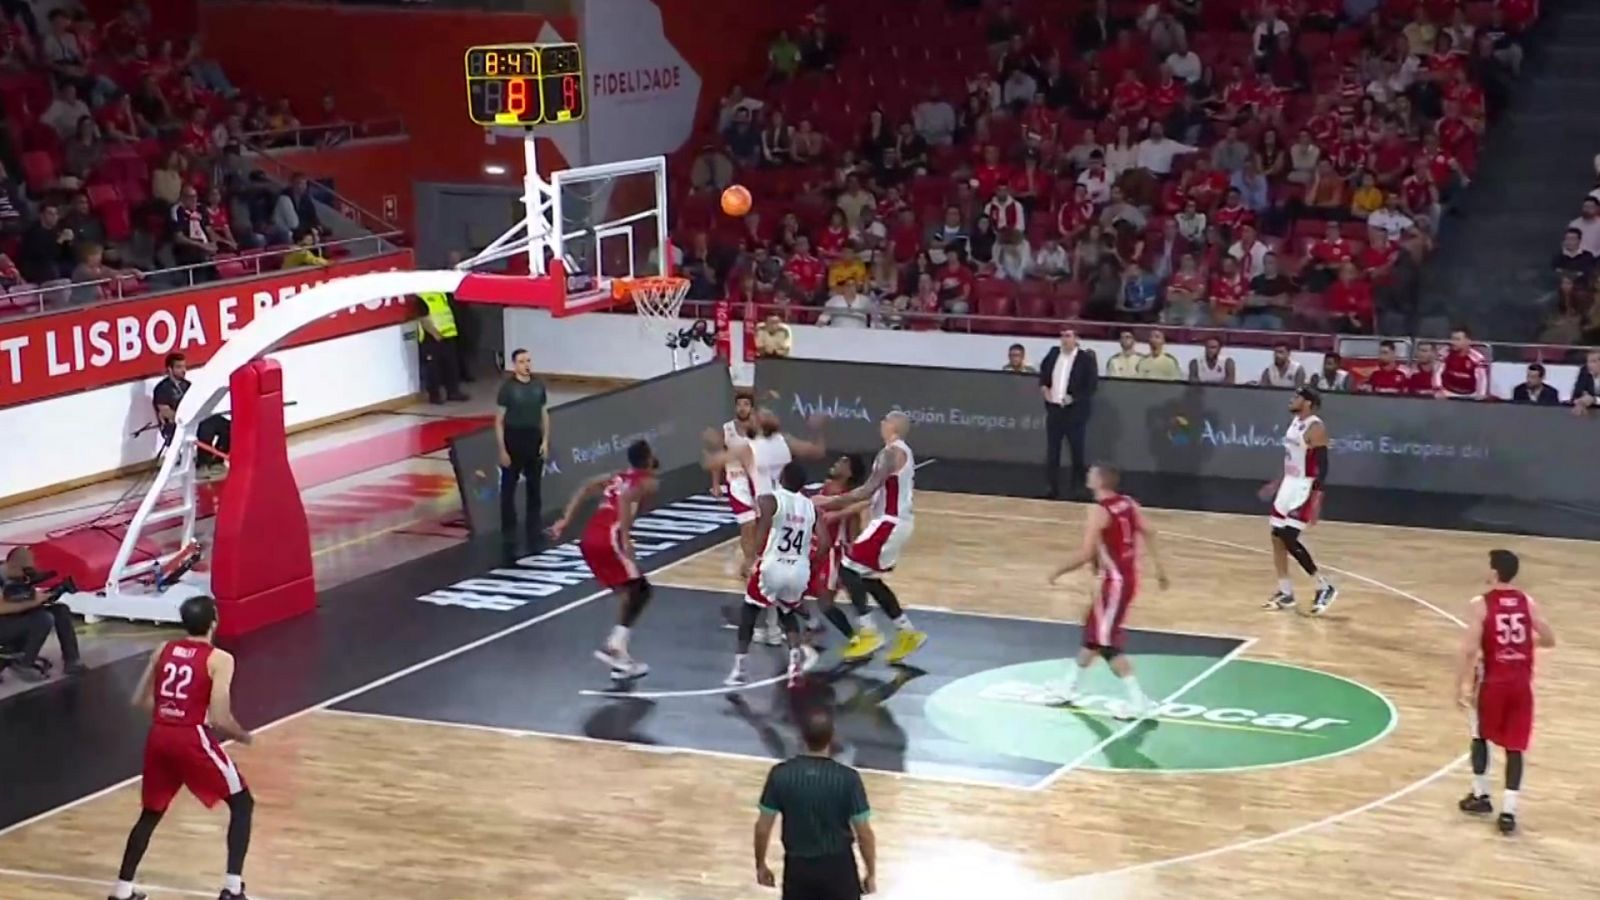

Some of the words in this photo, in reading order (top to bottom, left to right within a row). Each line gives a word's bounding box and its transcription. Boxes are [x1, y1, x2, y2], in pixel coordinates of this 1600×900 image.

[486, 52, 536, 76] 8:47
[508, 77, 526, 114] 8
[593, 65, 680, 96] FIDELIDADE
[46, 304, 207, 376] LISBOA
[949, 408, 1016, 432] Europea
[1378, 436, 1455, 461] Europea
[777, 525, 804, 556] 34
[1495, 613, 1526, 645] 55
[160, 662, 193, 699] 22
[978, 680, 1351, 731] Erpcar
